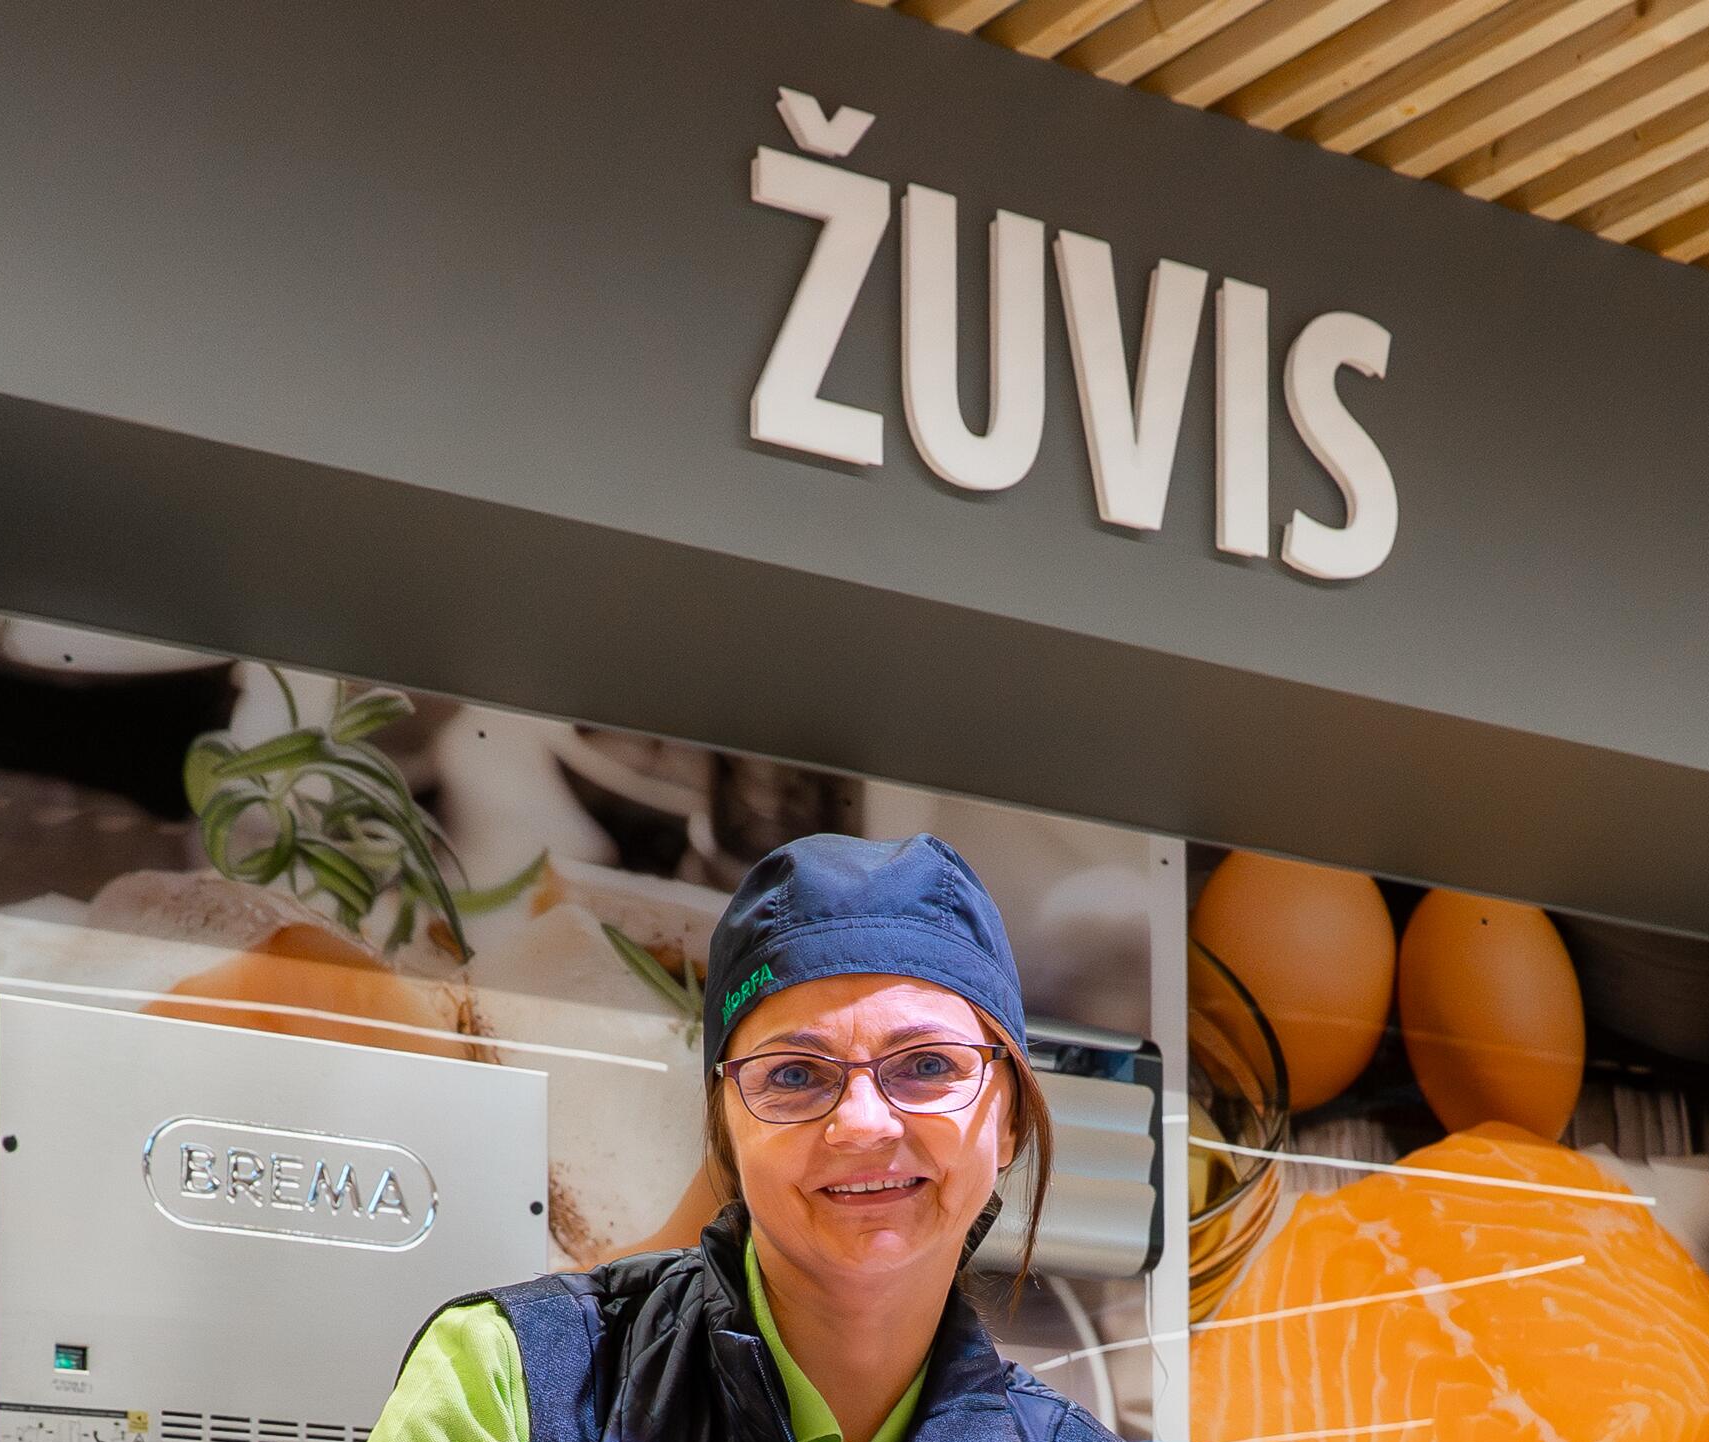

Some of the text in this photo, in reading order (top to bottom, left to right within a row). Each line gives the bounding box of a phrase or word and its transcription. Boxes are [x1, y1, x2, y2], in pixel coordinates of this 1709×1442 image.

[749, 85, 1399, 580] ŽUVIS
[721, 963, 774, 1026] NORFA
[180, 1143, 411, 1224] BREMA
